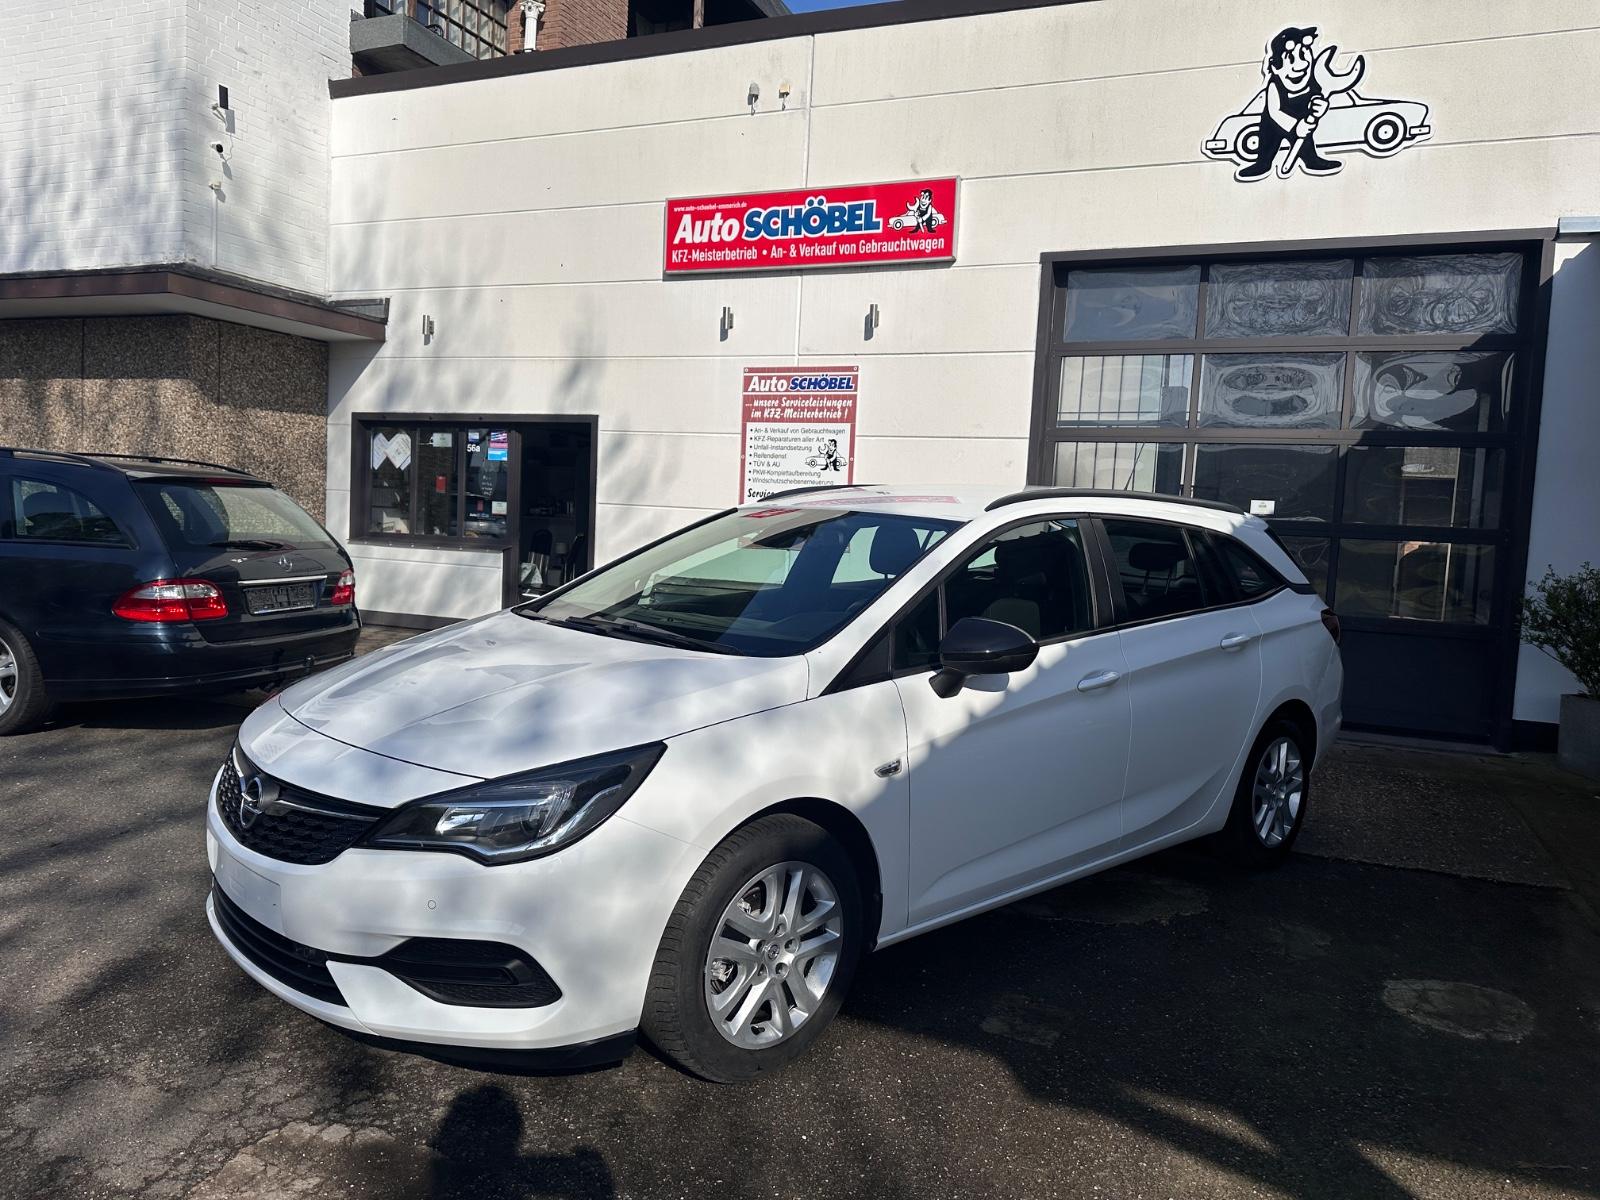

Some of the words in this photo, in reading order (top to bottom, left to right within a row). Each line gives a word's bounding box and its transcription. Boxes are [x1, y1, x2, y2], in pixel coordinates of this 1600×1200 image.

[673, 212, 740, 244] Auto
[742, 195, 882, 241] SCHÖBEL
[672, 246, 757, 263] KFZ-Meisterbetrieb
[770, 245, 788, 259] An-
[789, 244, 797, 257] &
[799, 241, 837, 257] Verkauf
[839, 240, 857, 255] von
[859, 237, 945, 254] Gebrauchtwagen
[748, 376, 787, 392] Auto
[789, 374, 855, 391] SCHÖBEL
[781, 396, 853, 409] Serviceleistungen
[751, 408, 761, 418] im
[763, 407, 842, 418] KFZ-Meisterbetrieb
[800, 427, 846, 435] Gebrauchtwagen
[753, 435, 802, 443] KFZ-Reparaturen
[467, 444, 480, 452] 56a
[753, 444, 812, 452] Unfall-Instandsetzung
